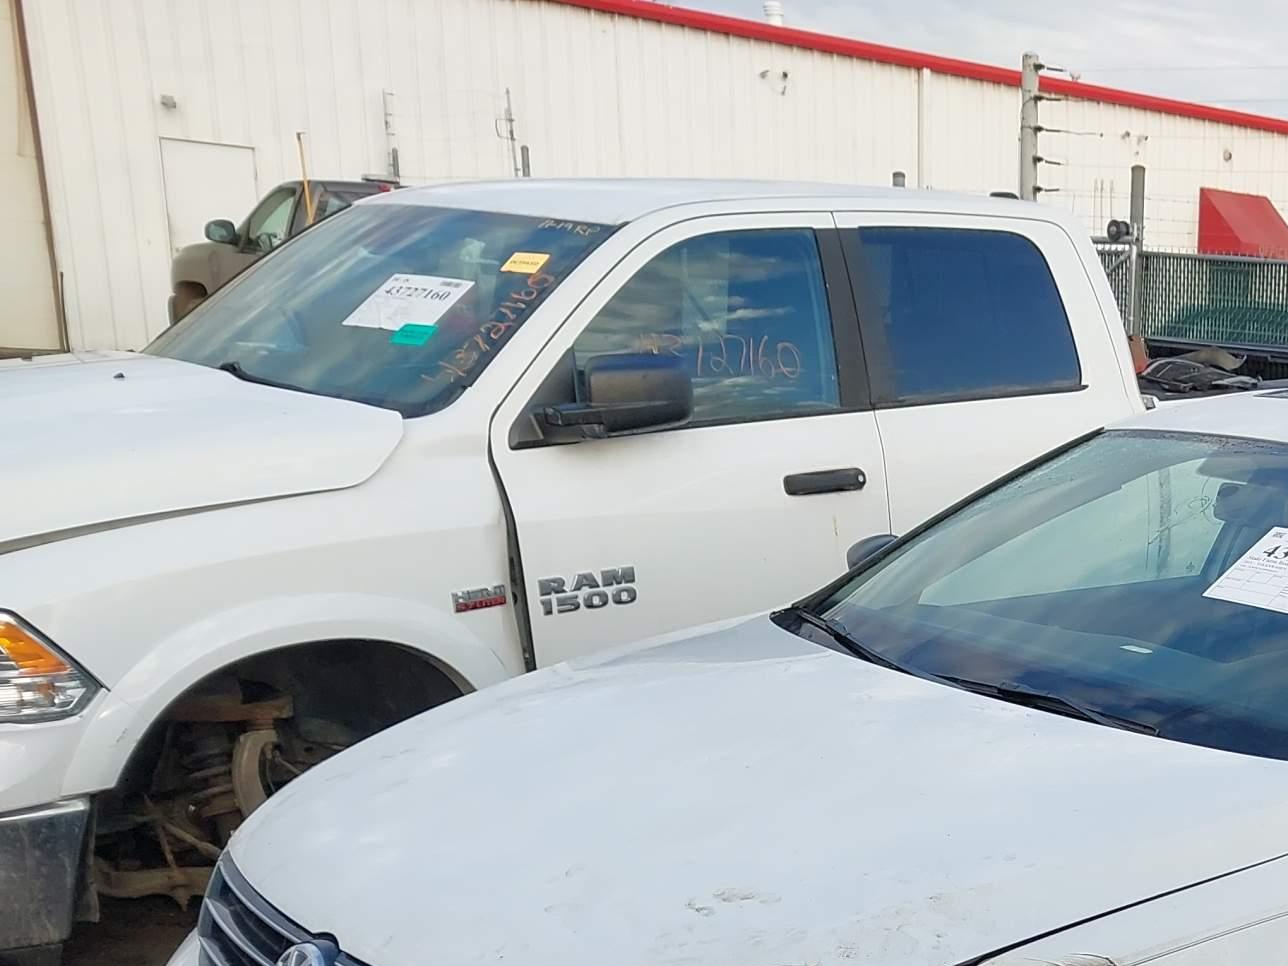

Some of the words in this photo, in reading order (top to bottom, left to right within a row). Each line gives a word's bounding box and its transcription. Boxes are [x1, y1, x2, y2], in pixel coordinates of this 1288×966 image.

[385, 286, 452, 301] 43727160
[537, 566, 636, 597] RAM
[539, 585, 637, 616] 1500
